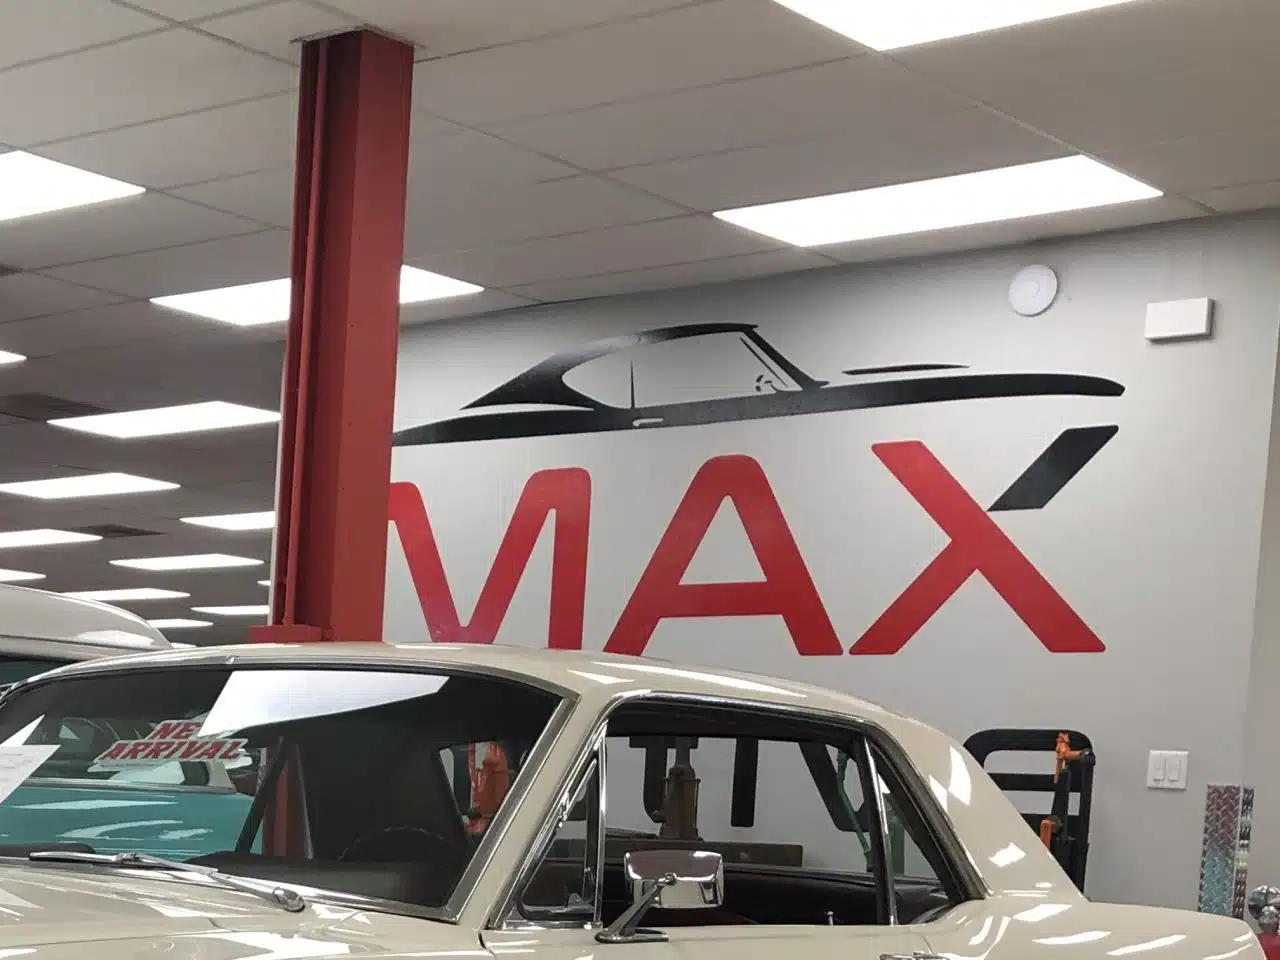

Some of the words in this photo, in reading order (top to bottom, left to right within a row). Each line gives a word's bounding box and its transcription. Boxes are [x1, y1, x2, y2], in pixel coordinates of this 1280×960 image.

[385, 424, 1120, 656] MAX
[151, 721, 203, 739] NE
[99, 741, 243, 760] ARRIVAL
